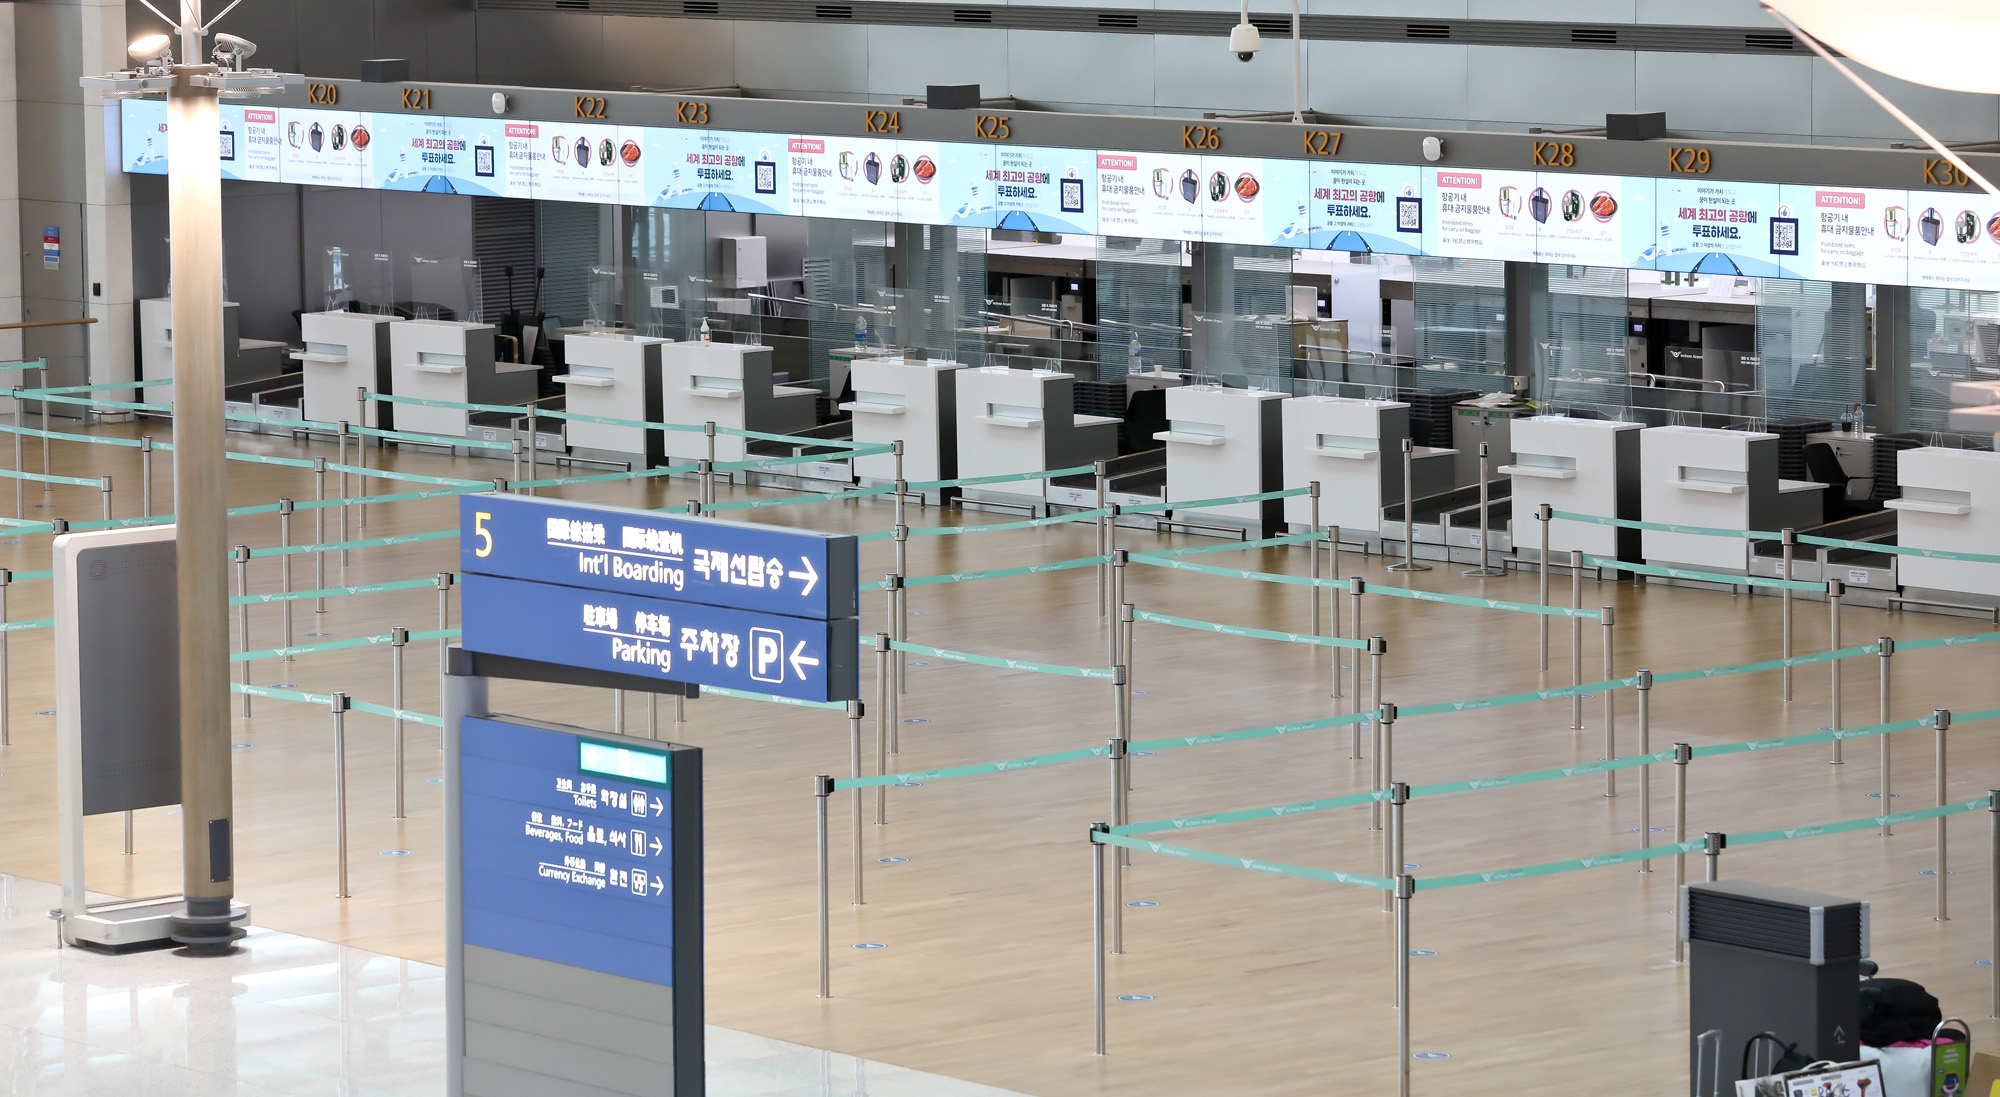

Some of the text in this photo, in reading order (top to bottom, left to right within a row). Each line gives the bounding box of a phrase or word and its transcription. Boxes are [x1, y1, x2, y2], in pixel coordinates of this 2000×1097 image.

[309, 85, 336, 104] K20
[403, 89, 429, 109] K21
[576, 98, 605, 118] K22
[677, 102, 707, 124] K23
[866, 111, 899, 133] K24
[976, 116, 1009, 138] K25
[1183, 126, 1219, 149] K26
[1304, 131, 1341, 155] K27
[686, 153, 745, 167] 세계 최고의 공항에
[1101, 159, 1133, 167] ATTENTION!
[1533, 142, 1573, 167] K28
[1669, 148, 1710, 173] K29
[986, 170, 1049, 184] 세계 최고의 공항에
[1442, 176, 1477, 185] ATTENTION!
[1924, 160, 1969, 186] K30
[1314, 188, 1384, 203] 세계 최고의 공항에
[1442, 192, 1467, 202] 항공기 내
[1821, 196, 1861, 205] ATTENTION!
[1327, 205, 1371, 218] 투표하세요.
[1678, 207, 1757, 223] 세계 최고의 공항에
[1821, 212, 1848, 223] 항공기 내
[1693, 225, 1741, 239] 투표하세요.
[475, 512, 493, 558] 5
[579, 552, 685, 591] Int'l Boarding
[693, 548, 783, 590] 국제선탑승
[612, 638, 671, 673] Parking
[680, 627, 740, 668] 주차장
[573, 794, 597, 809] Toilets
[601, 789, 627, 809] 화장실
[525, 824, 584, 845] Beverages, Food
[609, 829, 626, 848] 식사
[538, 865, 606, 890] Currency Exchange
[610, 868, 628, 888] 환전
